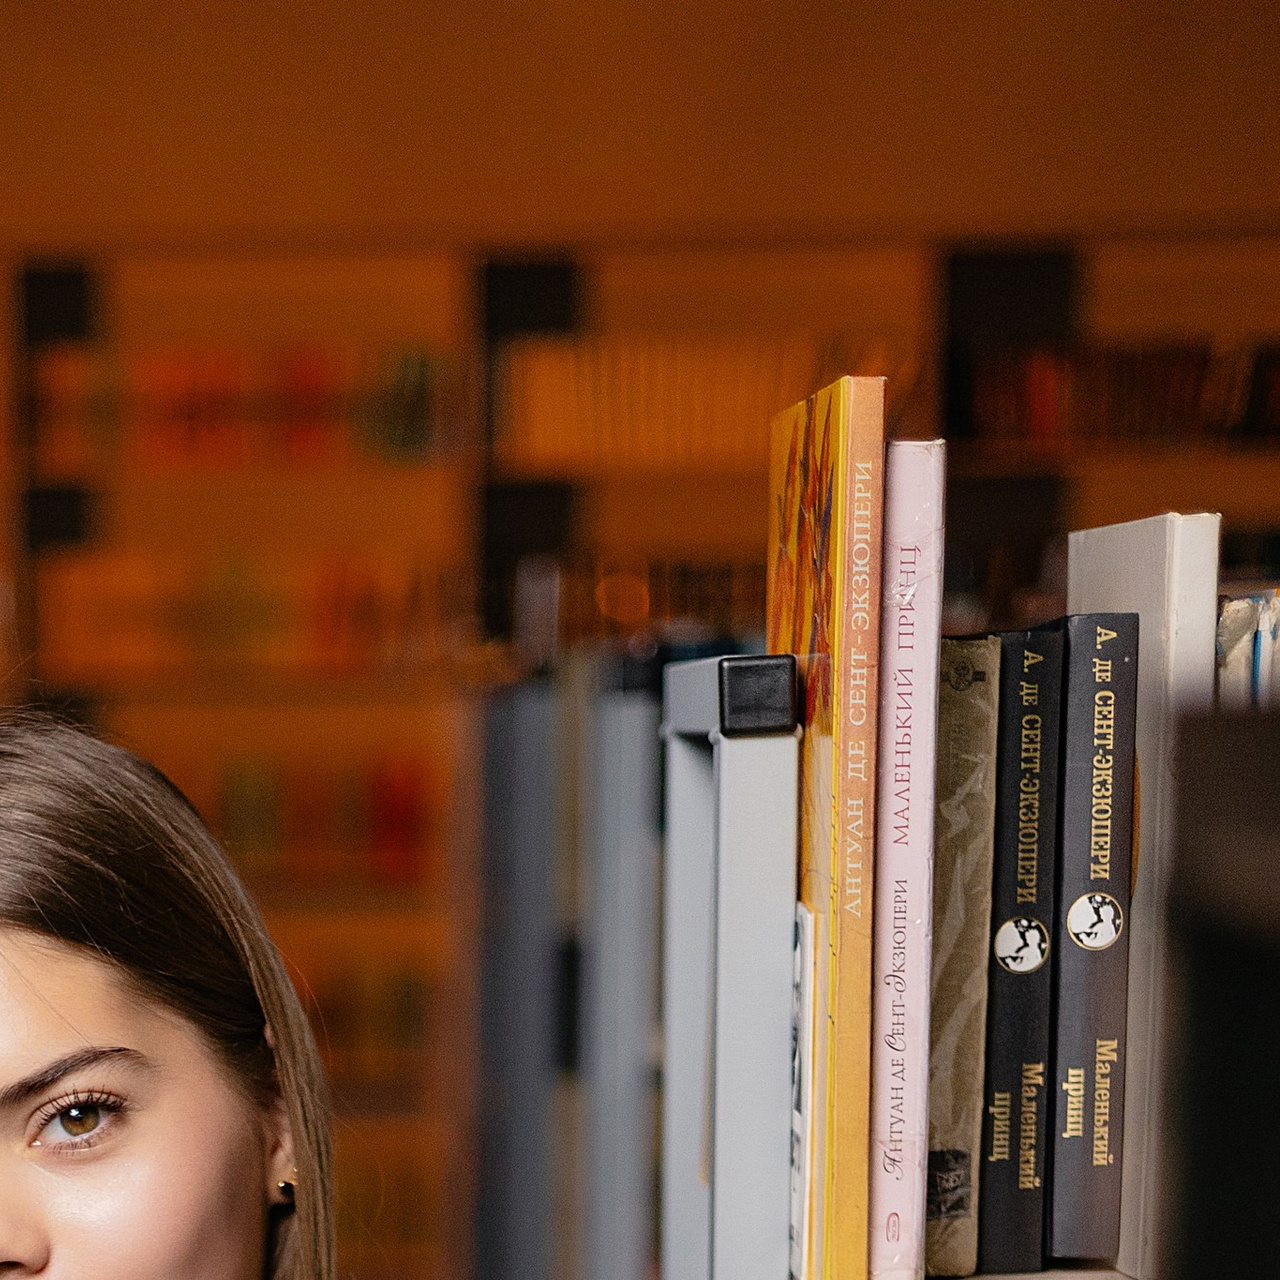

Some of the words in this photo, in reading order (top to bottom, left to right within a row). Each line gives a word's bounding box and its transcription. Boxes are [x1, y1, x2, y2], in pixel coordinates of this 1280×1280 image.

[898, 545, 922, 651] ПРИНЦ
[1096, 626, 1117, 649] А.
[1023, 650, 1044, 673] А.
[847, 741, 866, 782] ДЕ
[893, 667, 915, 845] МАЛЕНЬКИЙ
[1016, 714, 1042, 904] СЕНТ-ЭКЗЮПЕРИ
[1090, 690, 1115, 880] СЕНТ-ЭКЗЮПЕРИ
[842, 797, 865, 918] АНТУАН
[988, 1092, 1010, 1162] принц
[1019, 1062, 1044, 1190] Маленький
[1063, 1067, 1084, 1138] принц
[1092, 1039, 1118, 1167] Маленький
